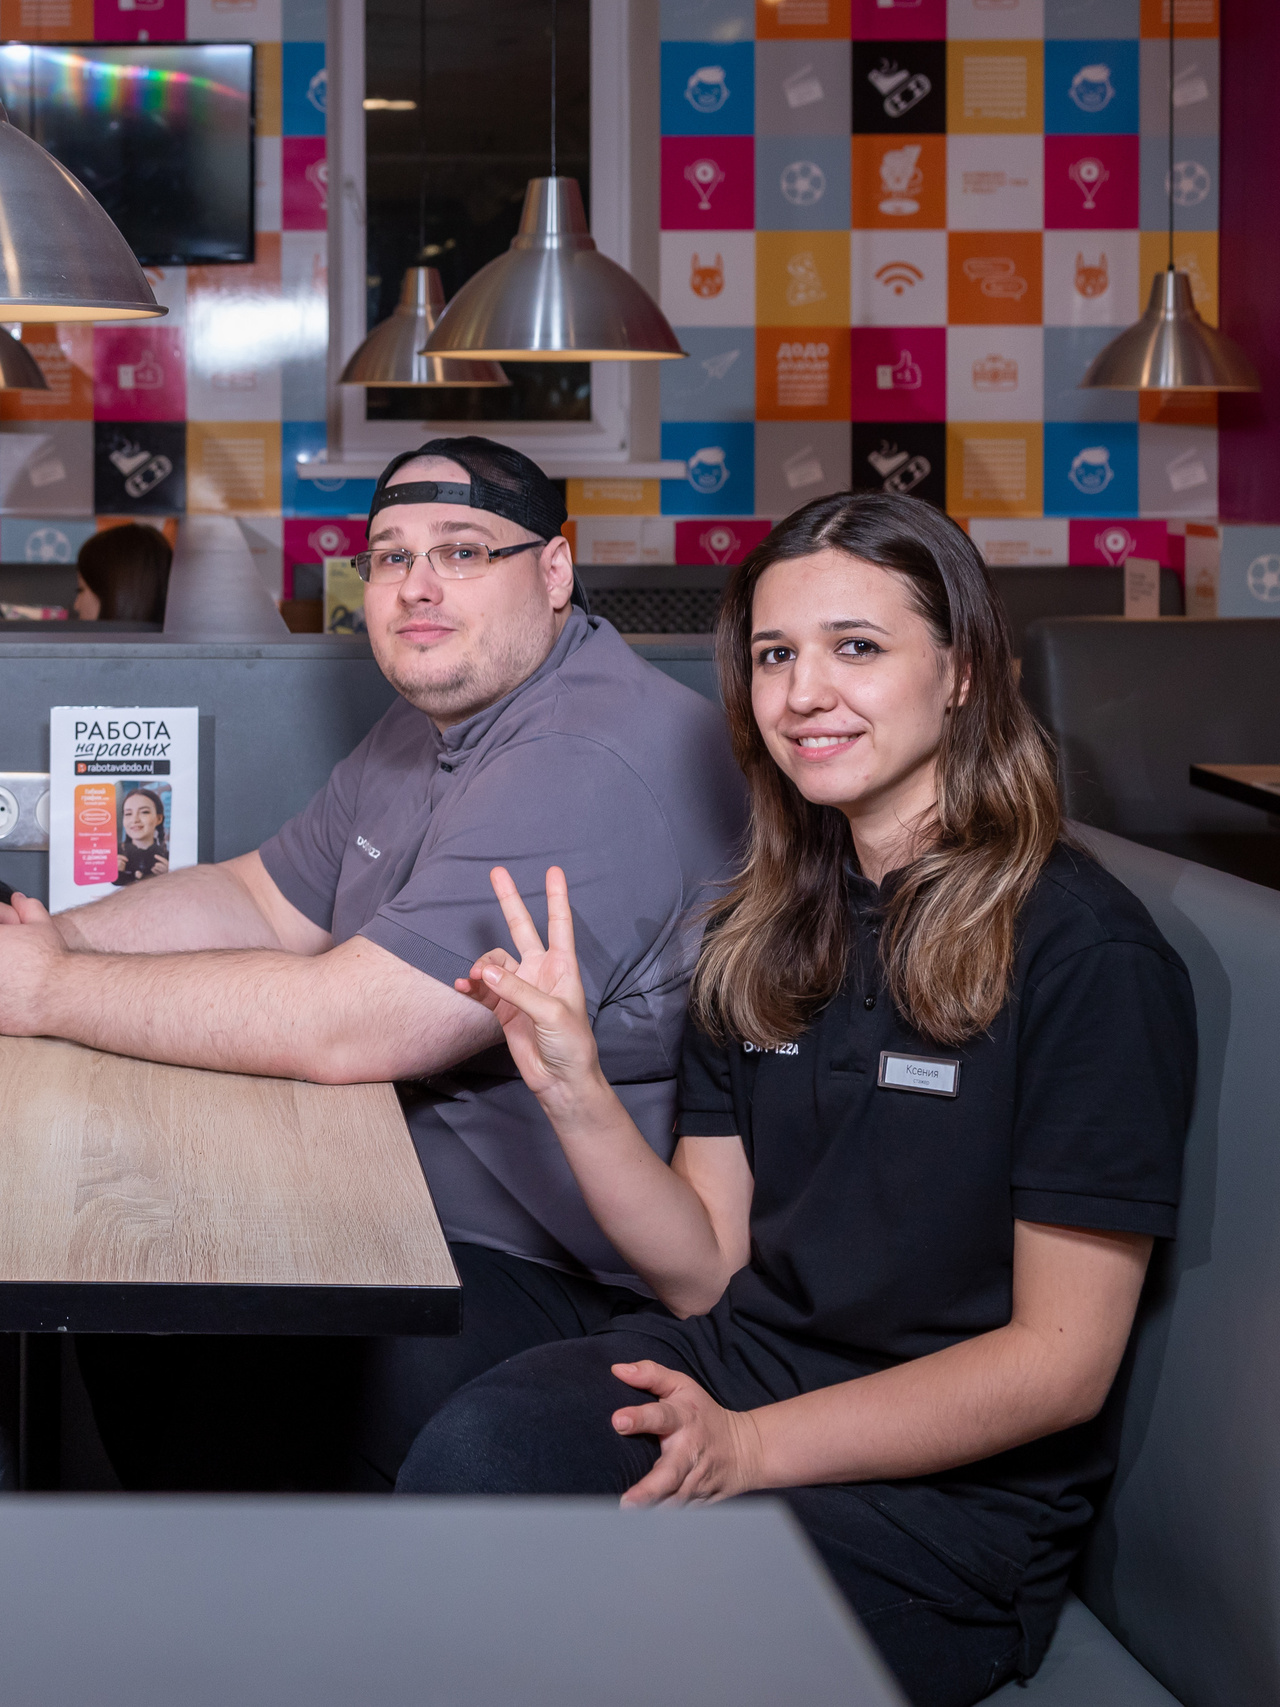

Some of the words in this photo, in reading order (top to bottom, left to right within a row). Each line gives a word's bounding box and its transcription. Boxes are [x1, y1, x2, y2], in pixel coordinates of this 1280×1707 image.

[75, 721, 171, 740] РАБОТА
[75, 743, 95, 757] на
[94, 743, 171, 761] равных
[906, 1064, 939, 1078] Ксения
